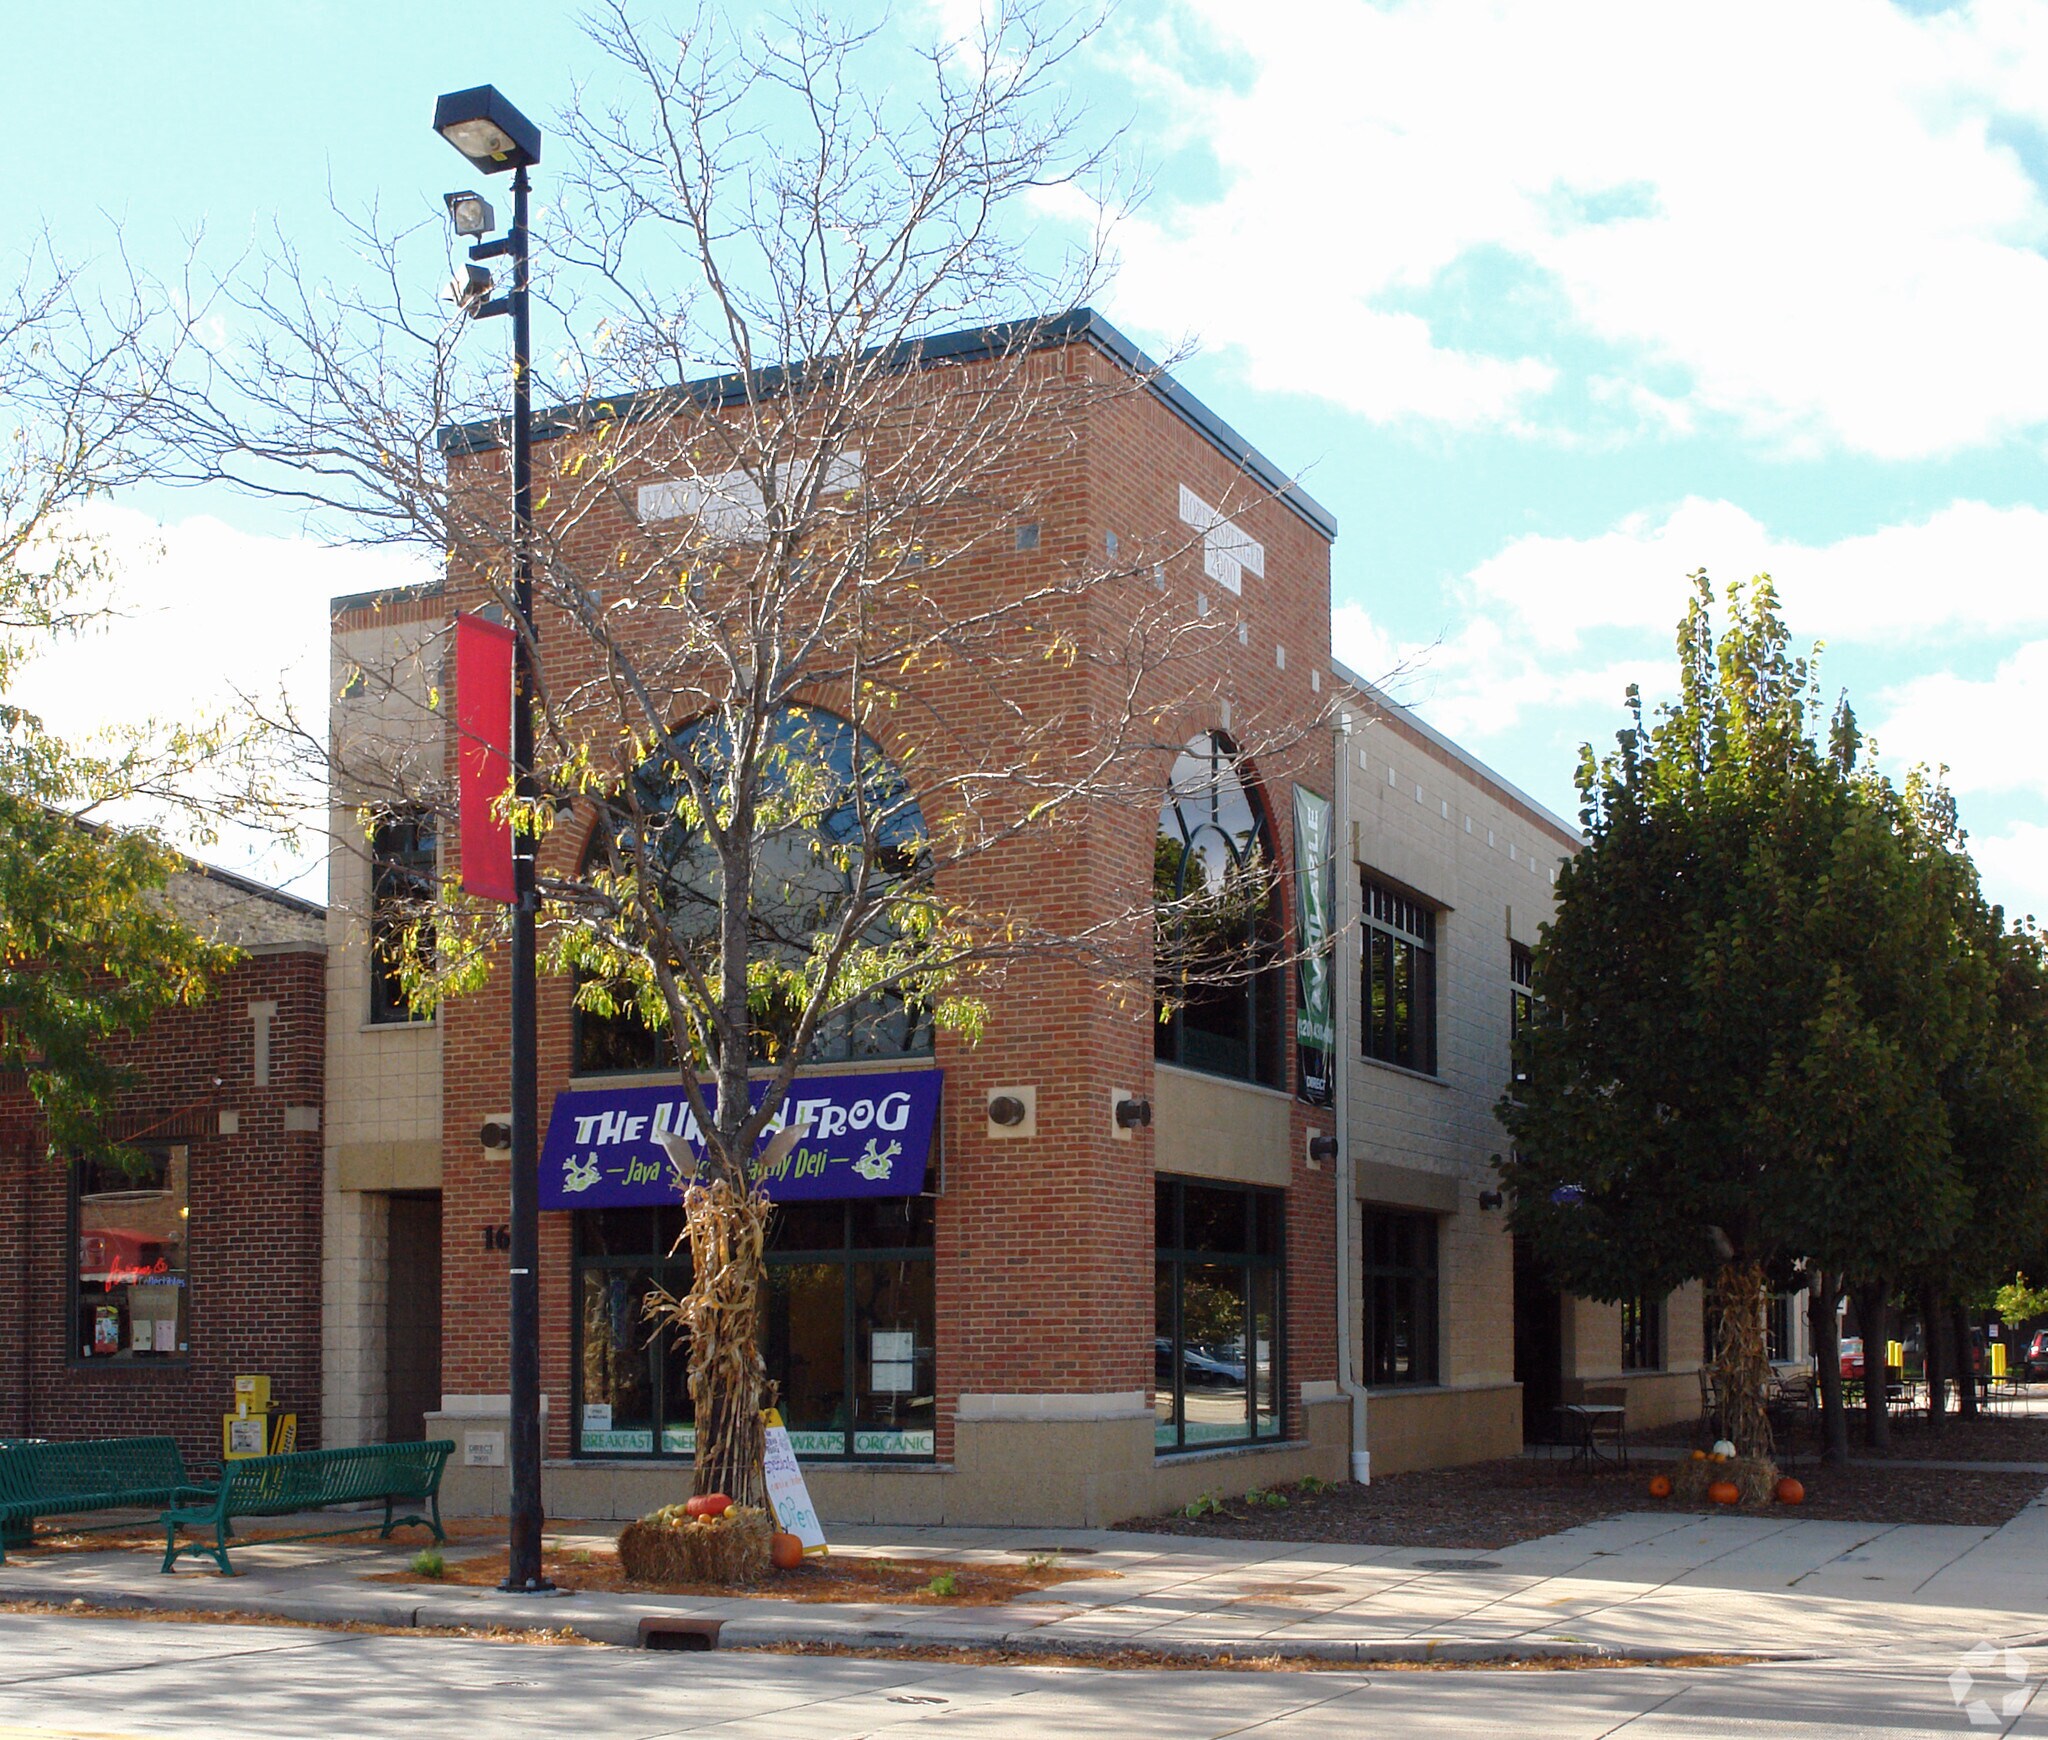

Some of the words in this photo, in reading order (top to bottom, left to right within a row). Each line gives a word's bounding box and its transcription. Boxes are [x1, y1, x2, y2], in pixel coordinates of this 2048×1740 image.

[574, 1110, 649, 1146] THE
[795, 1091, 911, 1140] FROG
[621, 1155, 661, 1186] Java
[794, 1148, 829, 1179] Deli
[280, 1424, 295, 1455] azette
[581, 1433, 652, 1449] BREAKFAST
[788, 1434, 845, 1451] WRAPS
[856, 1434, 932, 1451] ORGANIC
